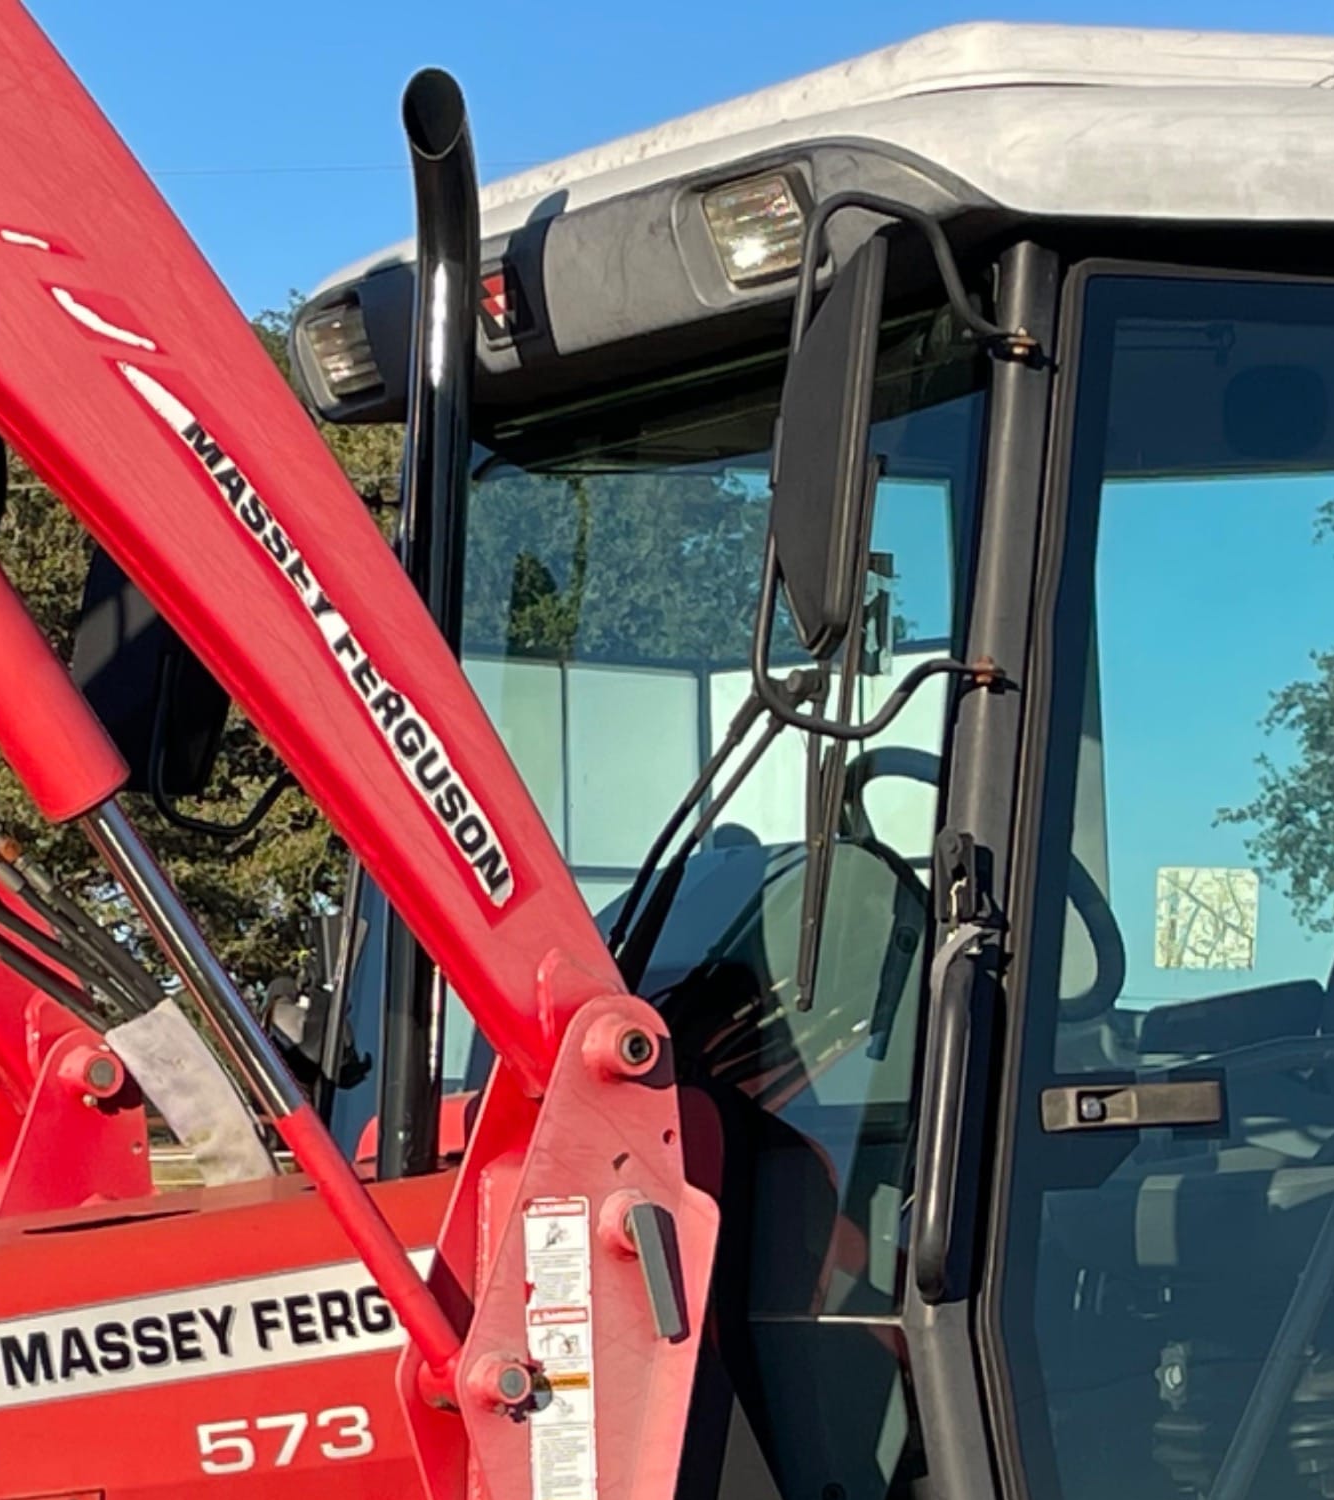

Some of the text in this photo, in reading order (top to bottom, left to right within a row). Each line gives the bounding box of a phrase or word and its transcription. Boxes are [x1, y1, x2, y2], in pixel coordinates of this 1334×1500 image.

[182, 422, 508, 888] MASSEY FERGUSON
[196, 1405, 376, 1475] 573
